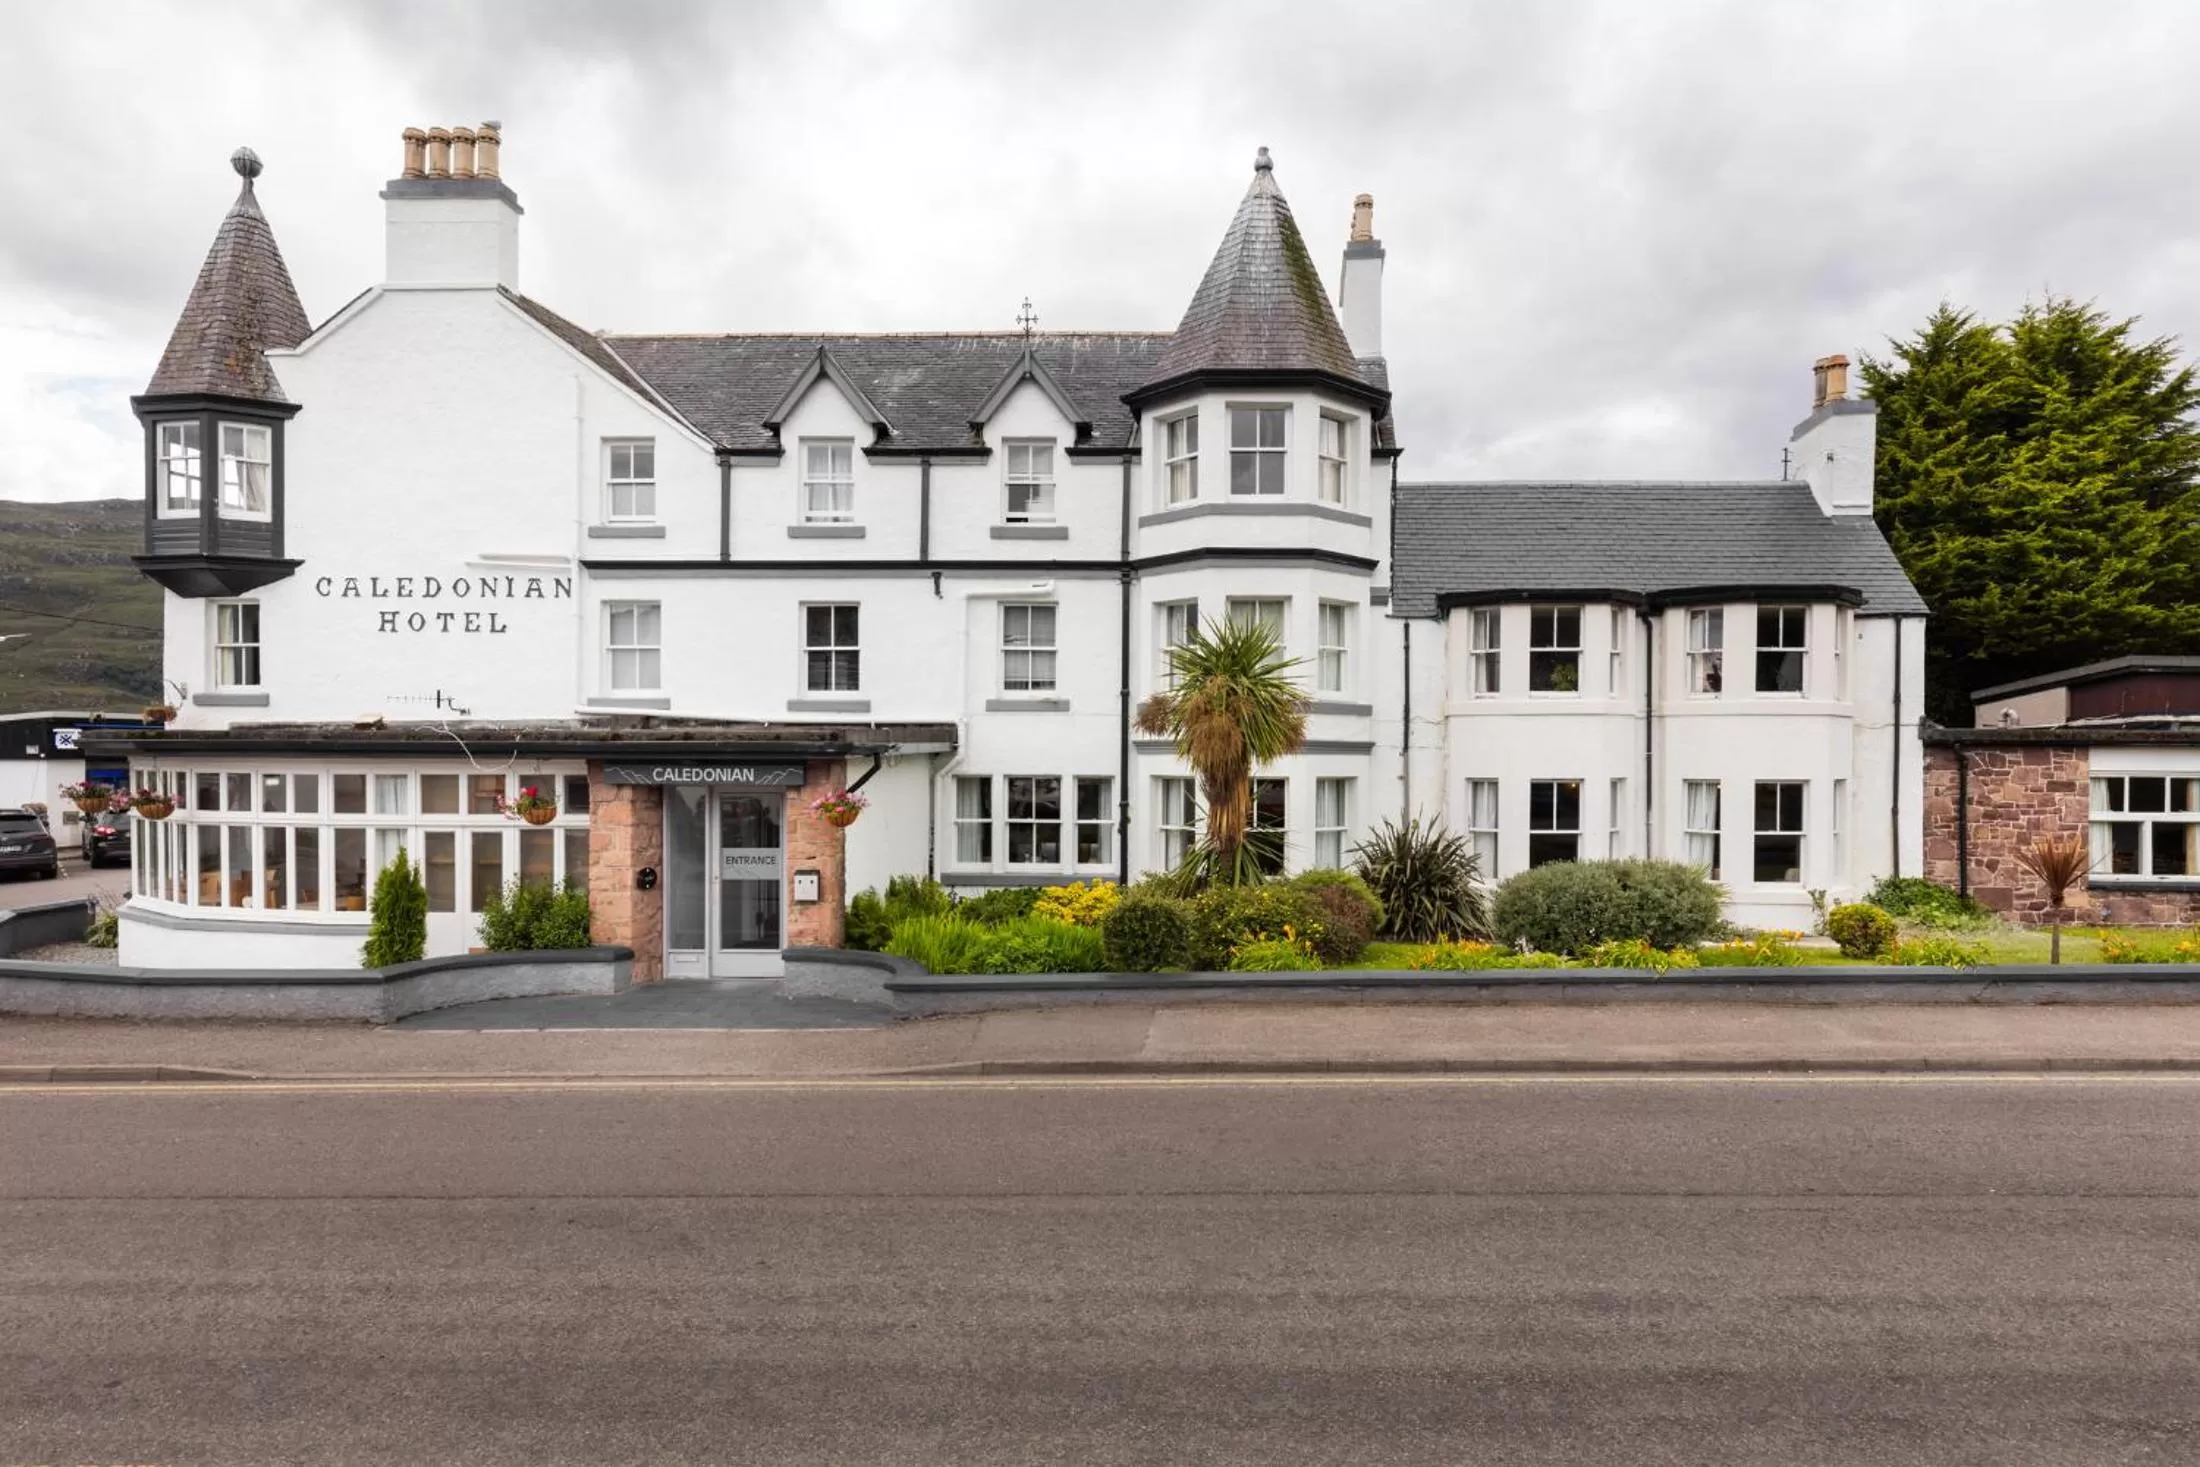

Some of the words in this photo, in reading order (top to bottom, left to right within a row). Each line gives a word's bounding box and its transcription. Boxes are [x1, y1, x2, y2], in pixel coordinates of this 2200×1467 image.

[315, 576, 572, 598] CALEDONIAN
[378, 611, 507, 633] HOTEL
[652, 768, 754, 782] CALEDONIAN
[725, 855, 777, 865] ENTRANCE
